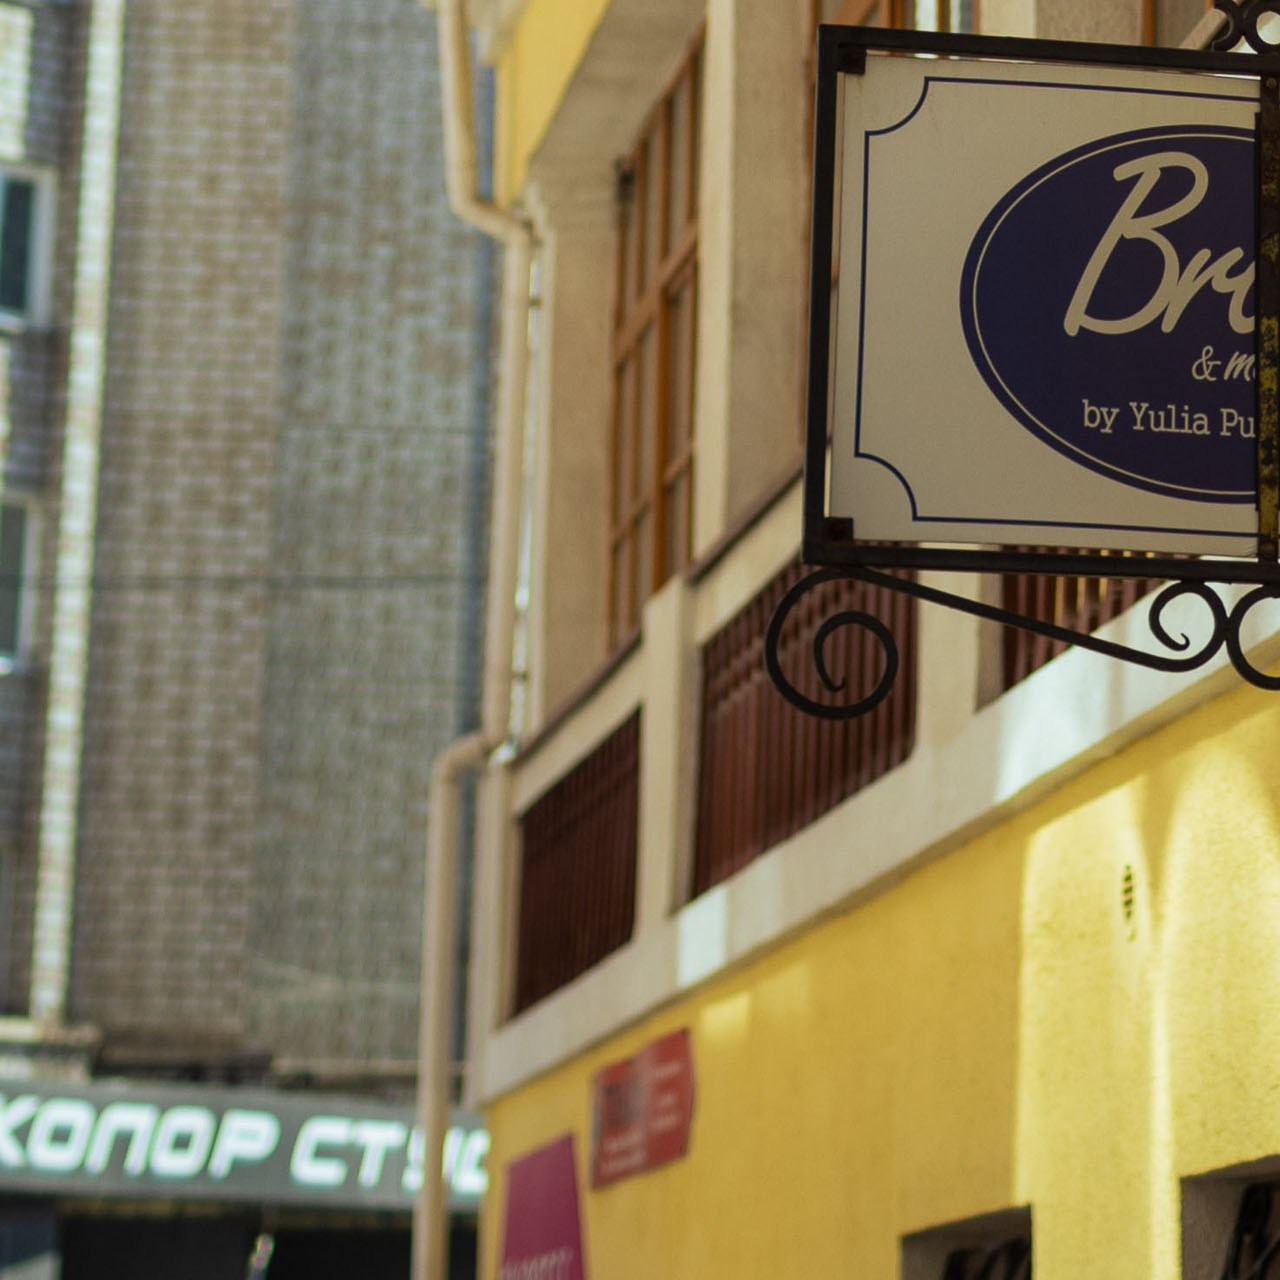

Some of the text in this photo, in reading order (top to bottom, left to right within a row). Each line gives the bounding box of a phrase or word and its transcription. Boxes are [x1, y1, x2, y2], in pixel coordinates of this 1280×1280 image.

[1191, 345, 1221, 381] &
[1082, 399, 1120, 434] by
[1129, 401, 1211, 435] Yulia
